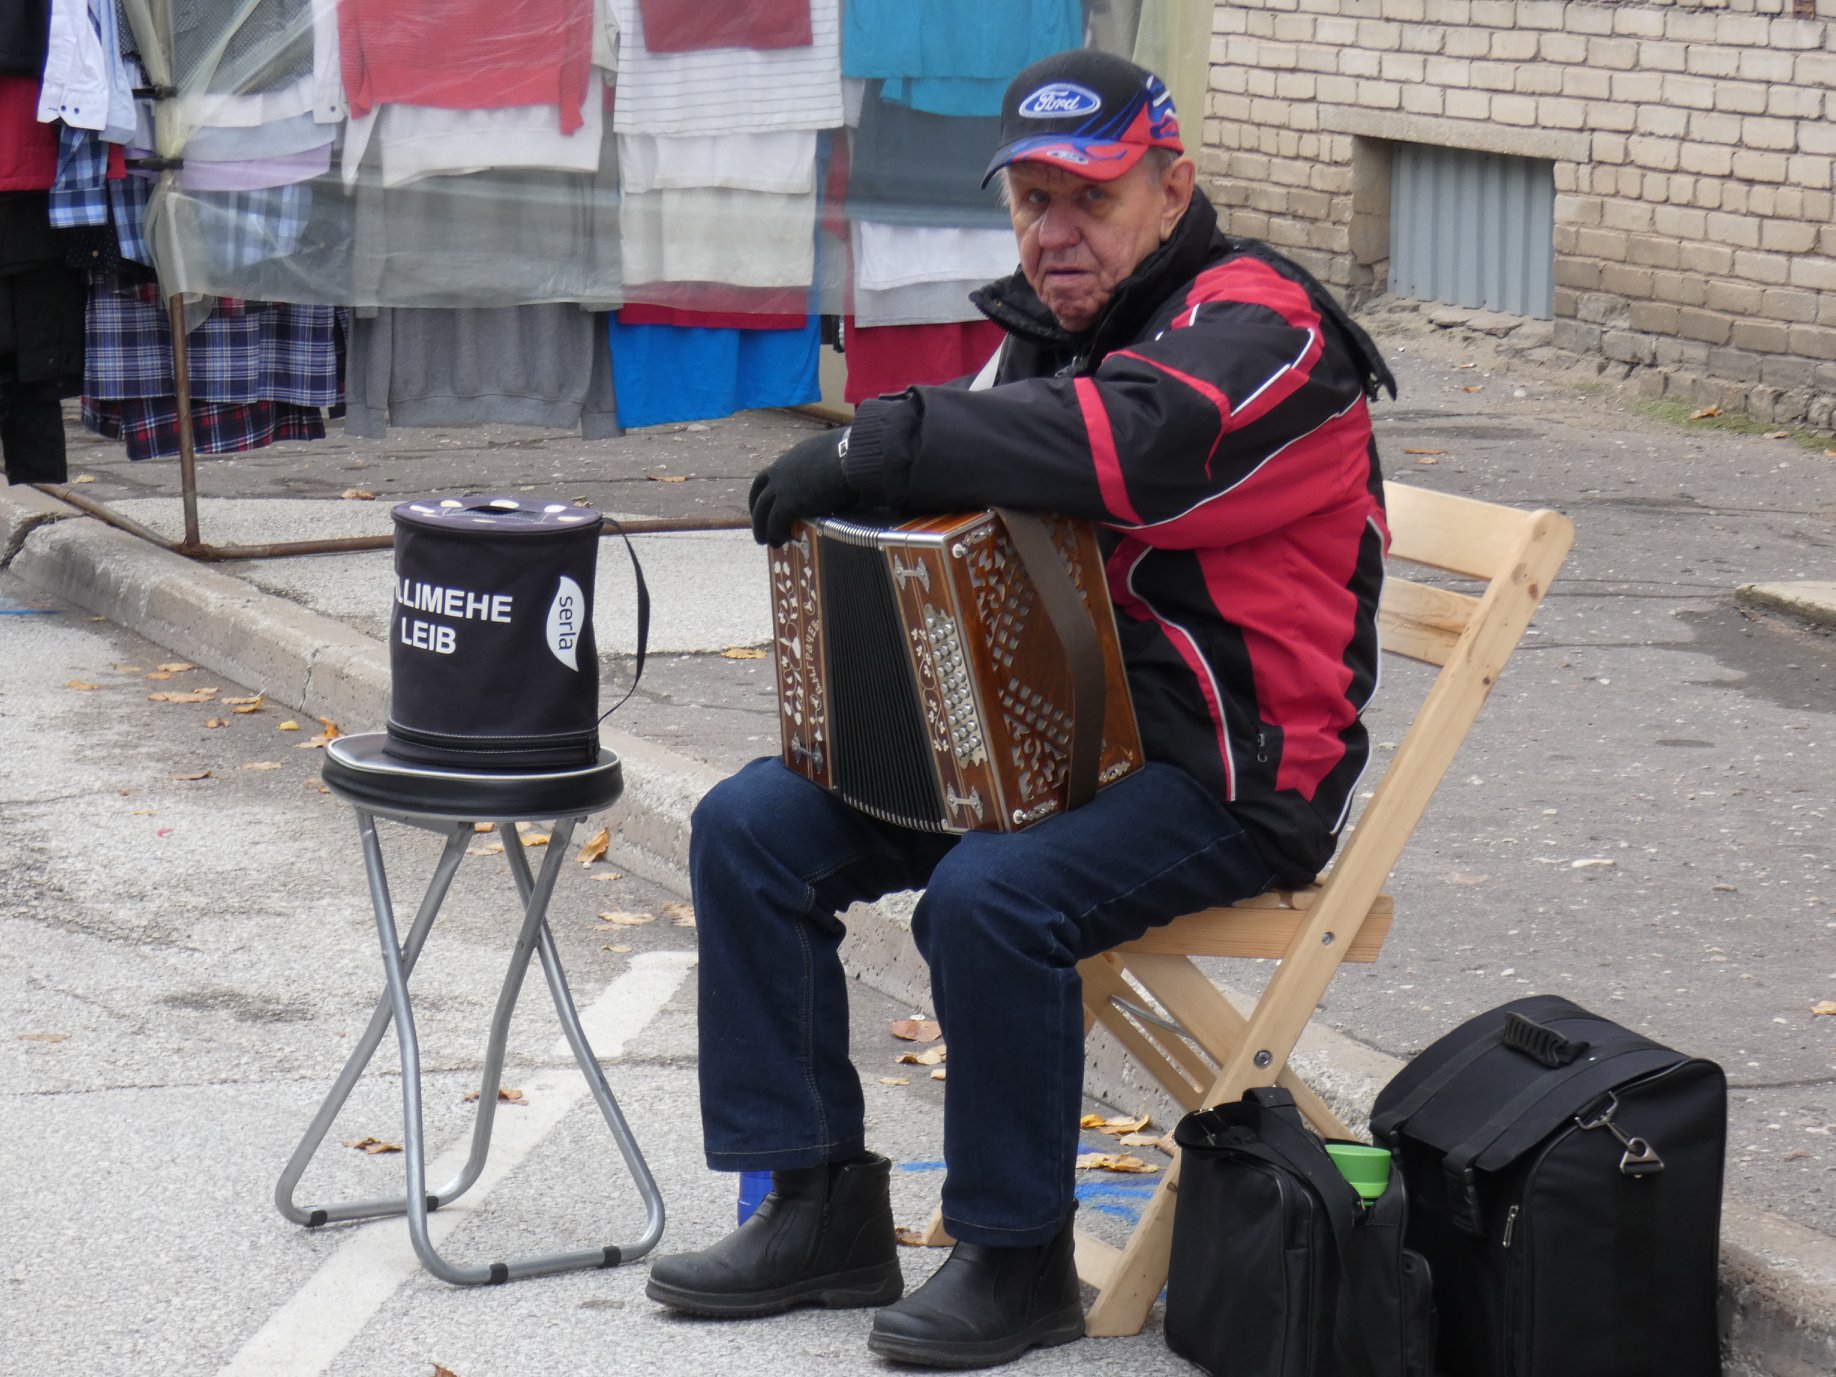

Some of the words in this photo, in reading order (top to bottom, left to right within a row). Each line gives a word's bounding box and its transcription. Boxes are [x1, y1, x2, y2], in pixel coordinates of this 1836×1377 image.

[1033, 90, 1081, 112] Ford
[401, 617, 456, 655] LEIB
[558, 596, 577, 651] serla
